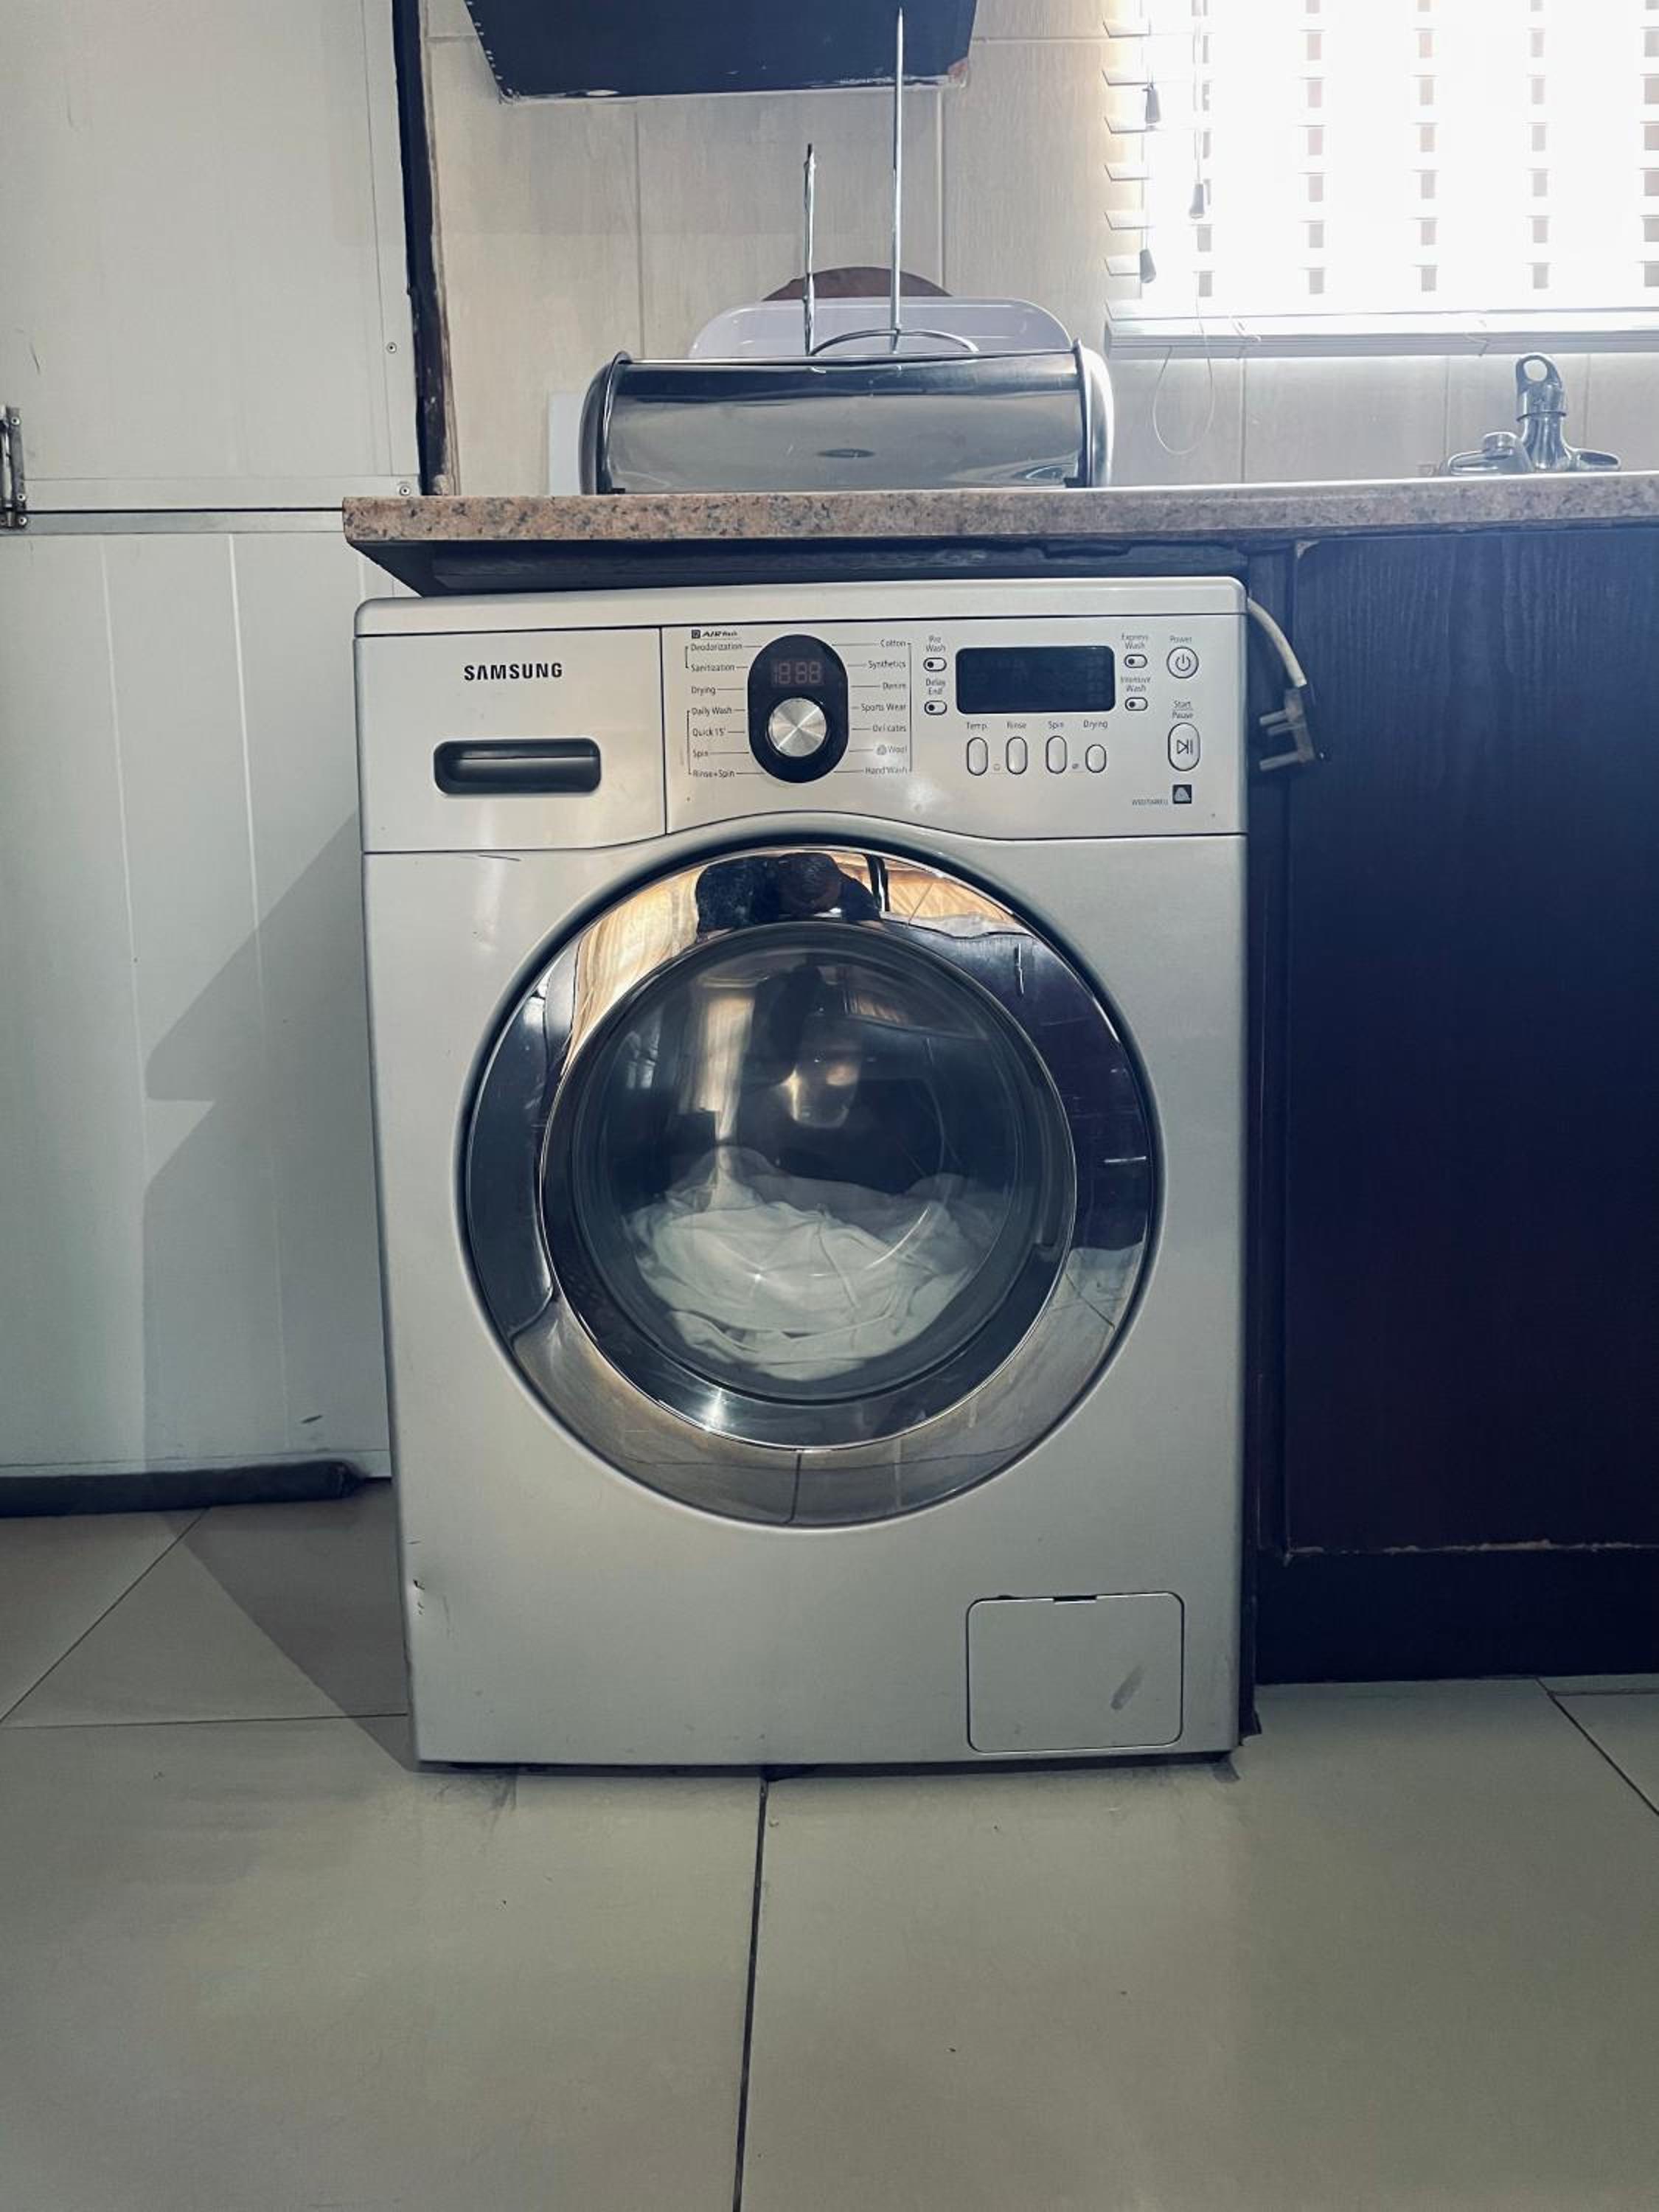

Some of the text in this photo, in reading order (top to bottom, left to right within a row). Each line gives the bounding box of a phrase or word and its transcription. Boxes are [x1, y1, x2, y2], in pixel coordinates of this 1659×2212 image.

[928, 635, 942, 643] Pre
[1121, 633, 1148, 641] Express
[691, 643, 742, 651] Deodorization
[880, 639, 906, 647] Cotton
[925, 644, 946, 652] Wash
[691, 664, 735, 672] Sanitization
[868, 660, 906, 669] Synthetics
[464, 663, 563, 681] SAMSUNG
[882, 682, 906, 690] Denim
[925, 678, 946, 687] Delay
[691, 686, 716, 696] Drying
[928, 687, 943, 695] End
[1126, 684, 1147, 692] Wash
[861, 703, 906, 713] Sports Wear
[1173, 700, 1192, 709] Start
[692, 707, 710, 717] Daily
[1172, 711, 1194, 719] Pause
[872, 723, 907, 732] Delicates
[1006, 721, 1027, 729] Rinse
[1048, 720, 1065, 730] Spin
[1083, 720, 1108, 730] Drying
[692, 728, 713, 737] Quick
[692, 749, 709, 758] Spin
[865, 766, 908, 774] Hand Wash
